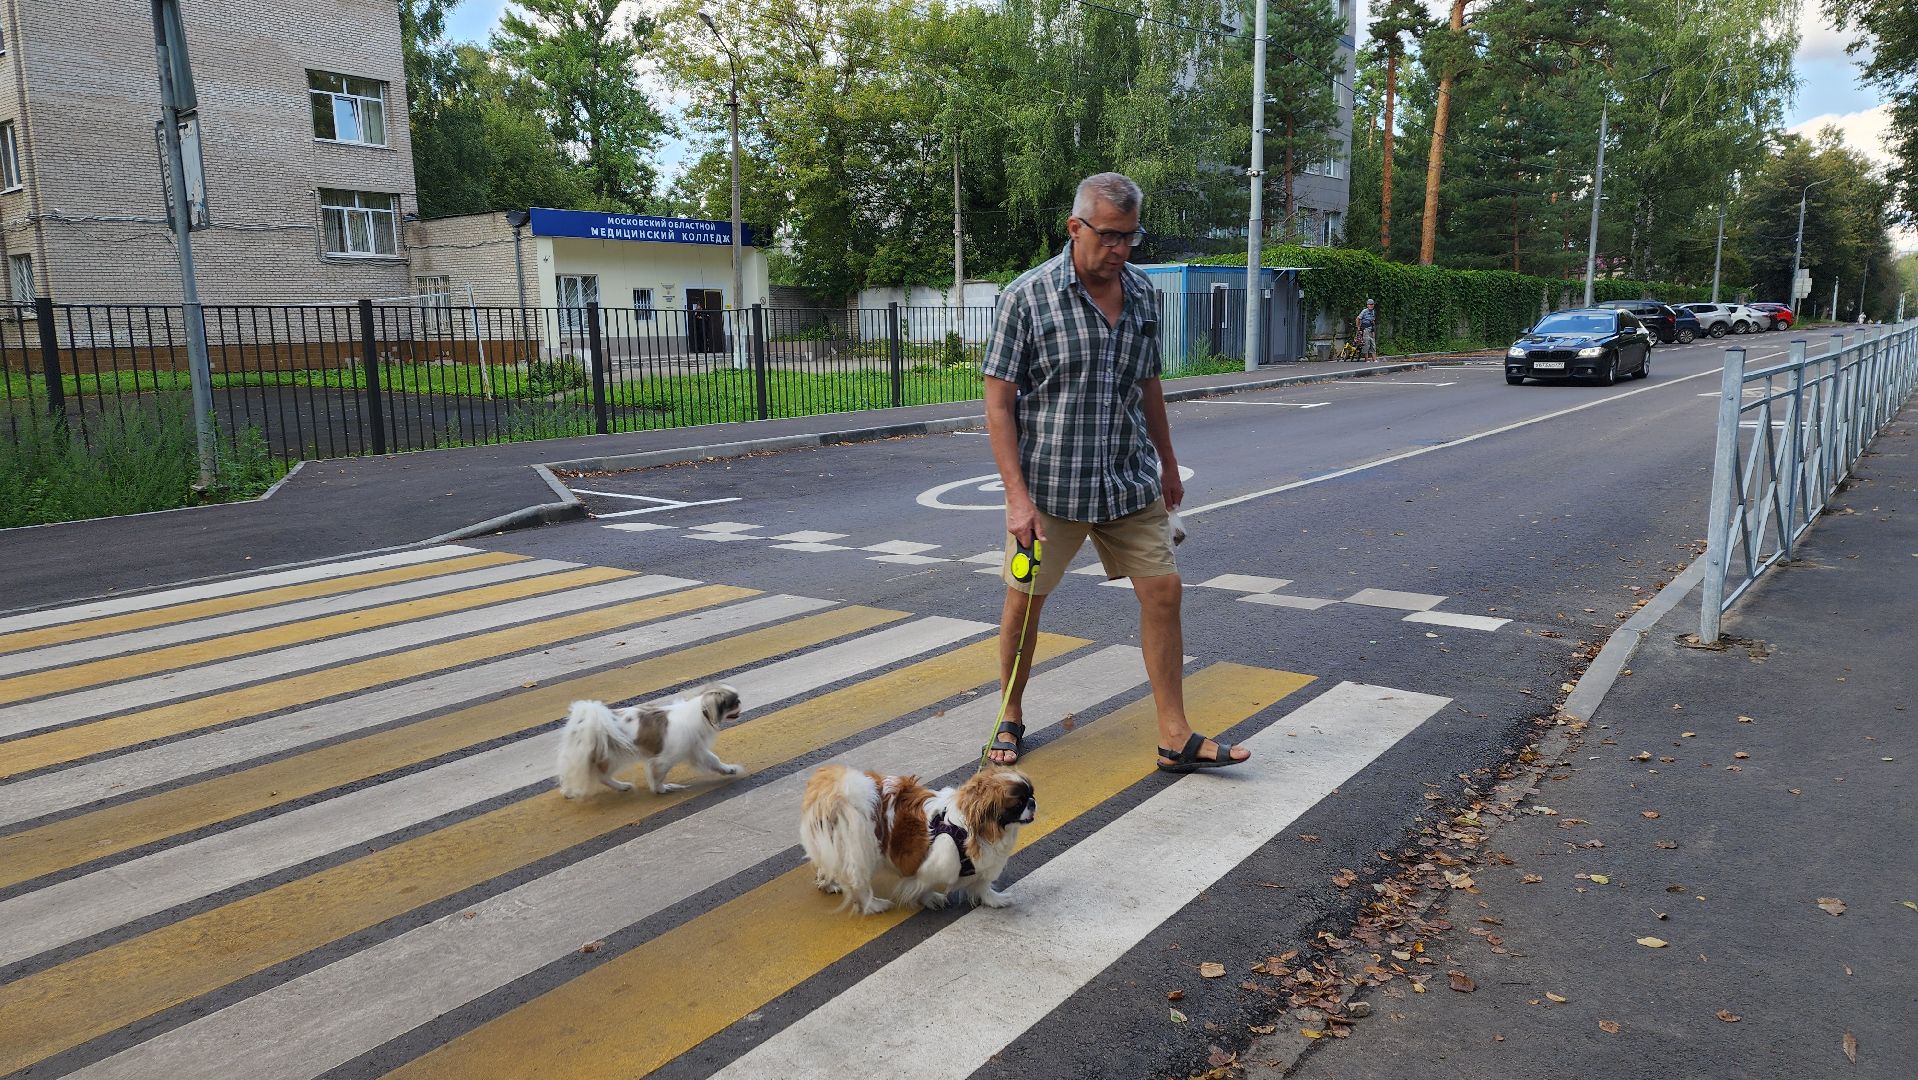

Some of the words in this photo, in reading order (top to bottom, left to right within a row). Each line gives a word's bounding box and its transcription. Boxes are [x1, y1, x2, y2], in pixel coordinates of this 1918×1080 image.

[607, 217, 667, 228] МОСКОВСКИЙ
[668, 221, 716, 231] ОБЛАСТНОЙ
[591, 227, 675, 240] МЕДИЦИНСКИЙ
[682, 232, 731, 243] КОЛЛЕДЖ
